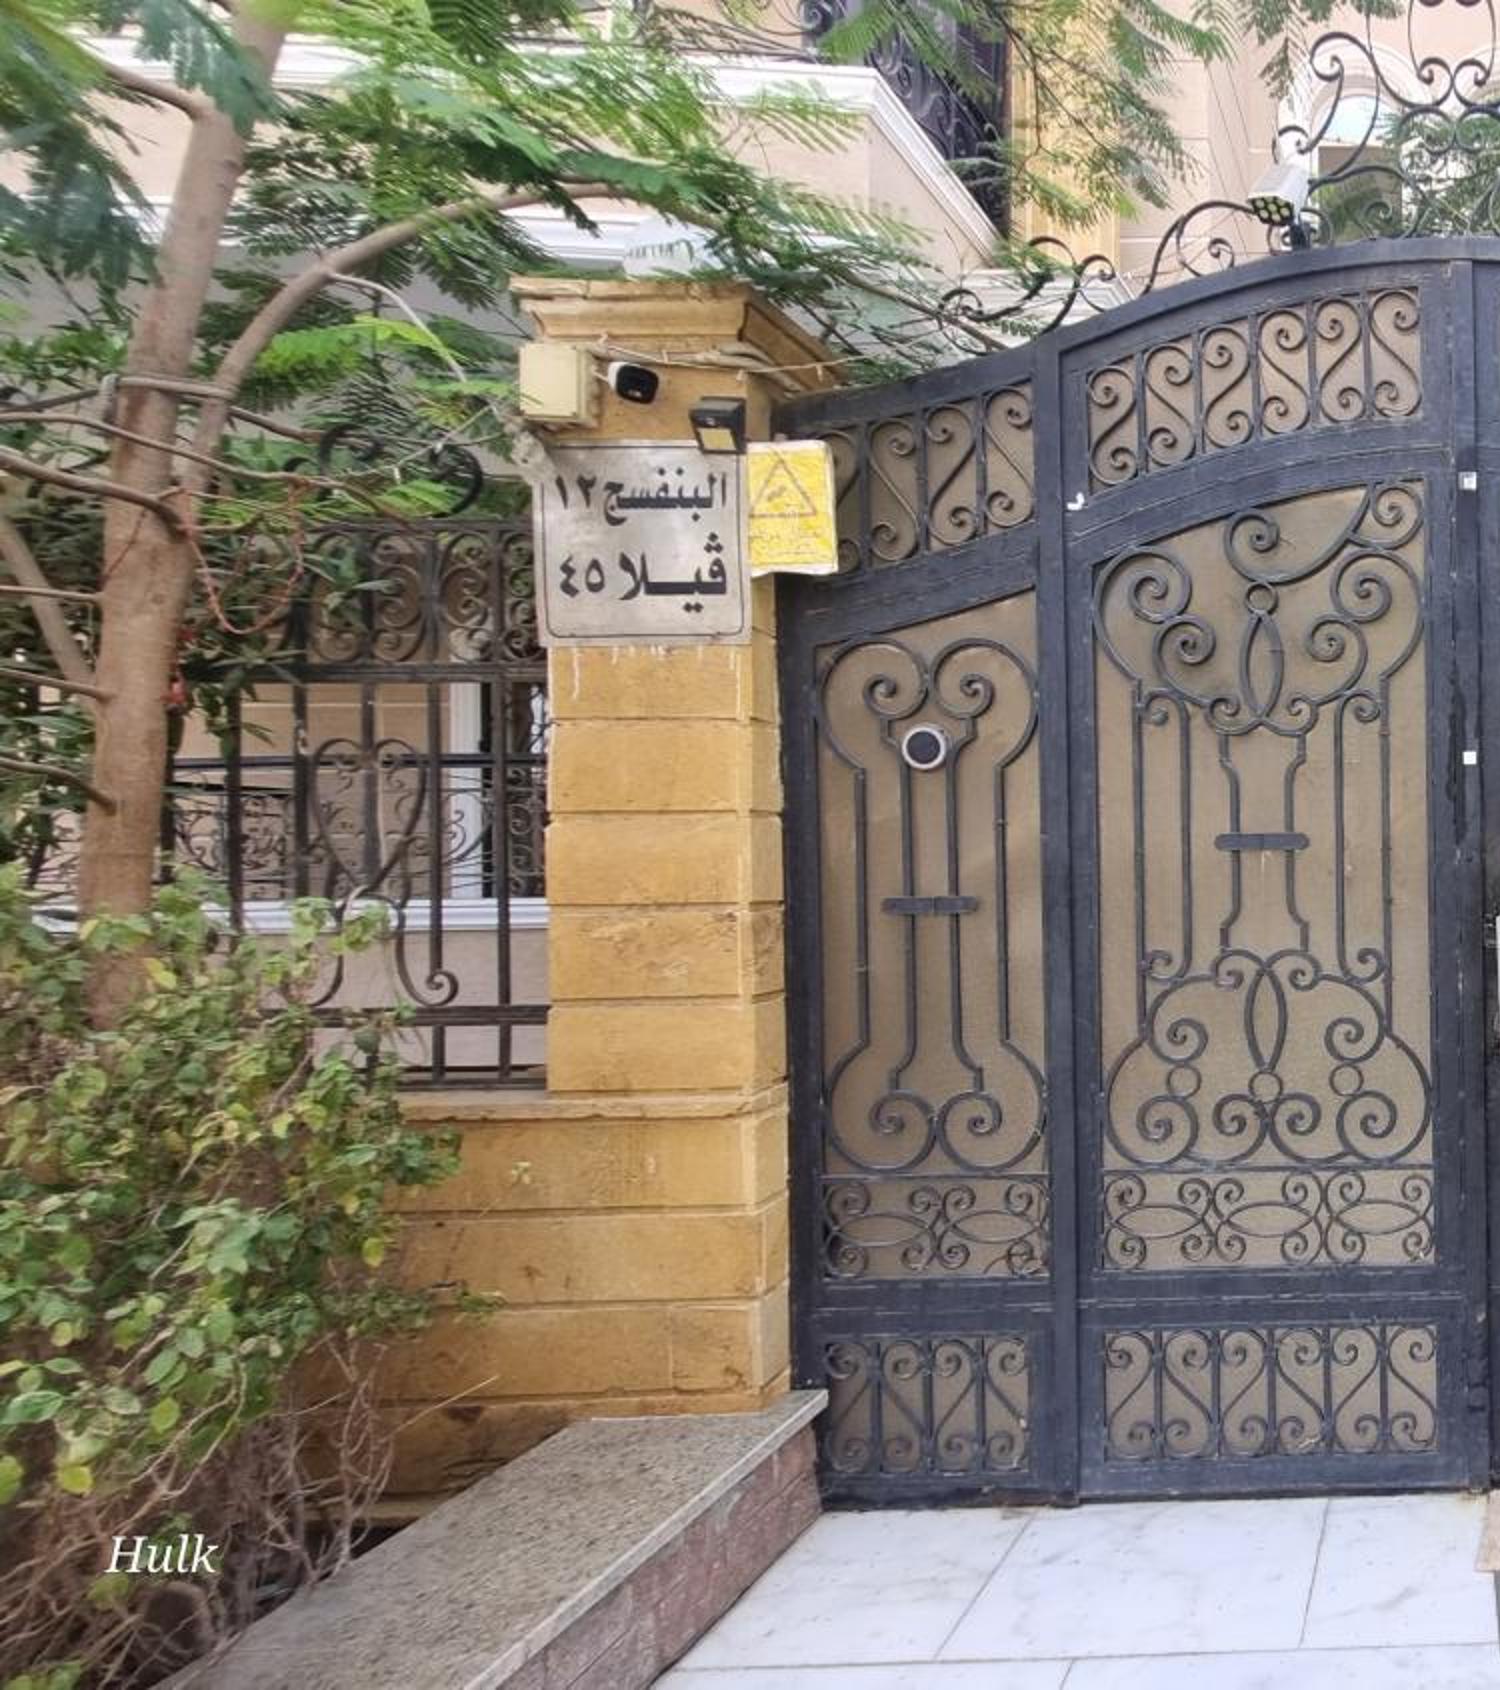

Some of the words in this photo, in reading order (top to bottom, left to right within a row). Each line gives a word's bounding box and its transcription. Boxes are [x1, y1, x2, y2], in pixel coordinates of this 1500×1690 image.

[554, 473, 598, 510] ١٢
[602, 466, 728, 527] البنفسج
[559, 554, 606, 599] ٤٥
